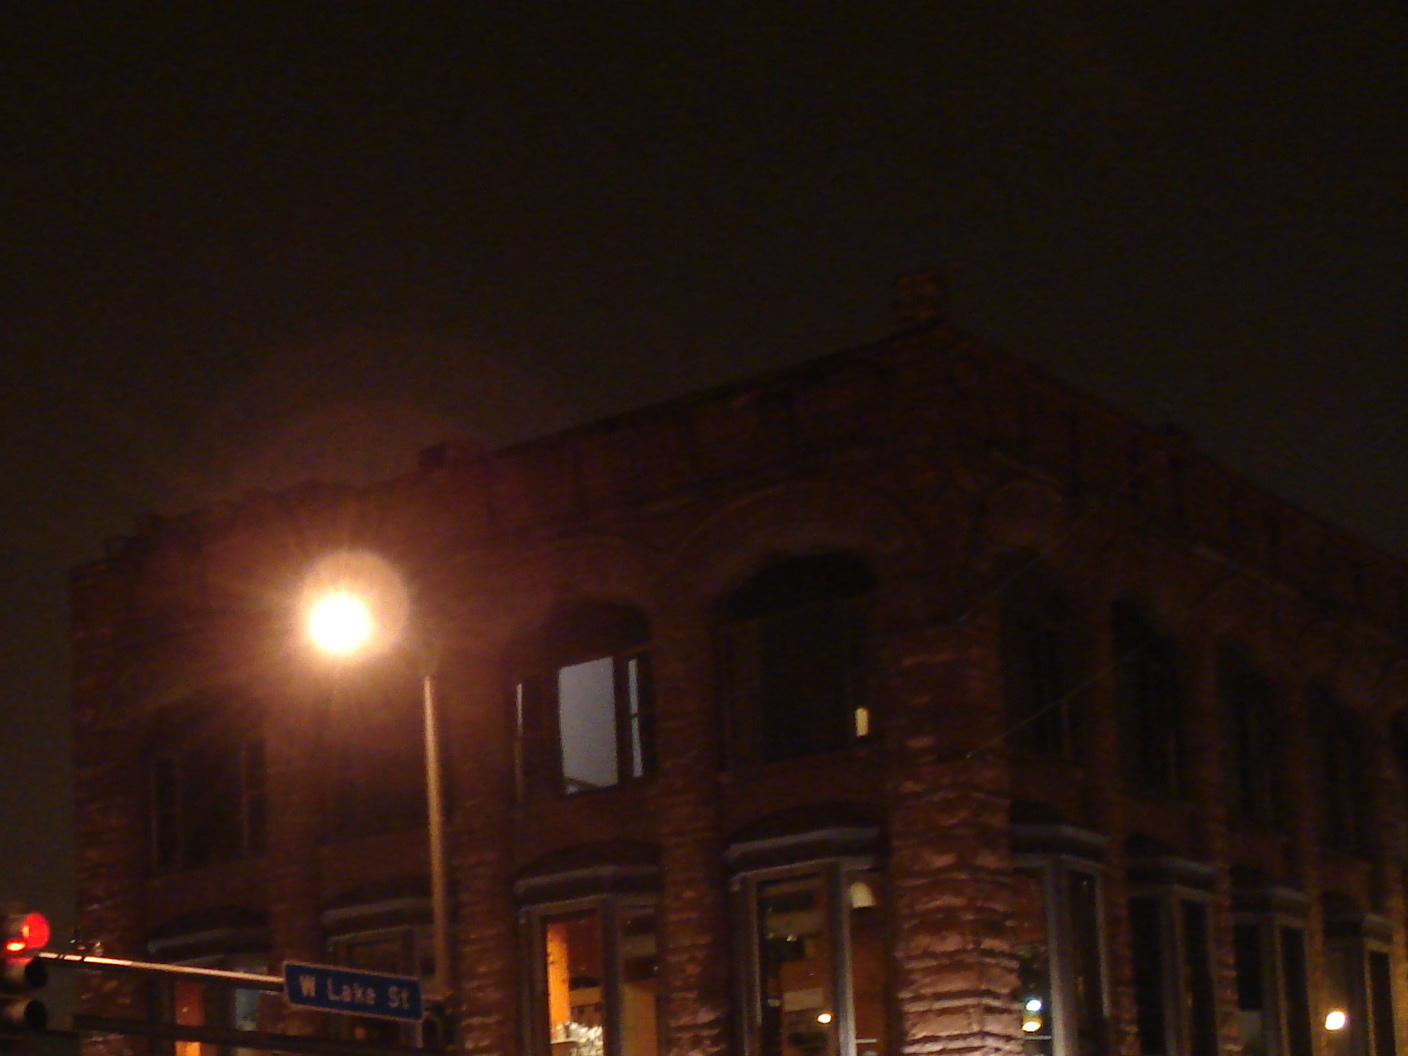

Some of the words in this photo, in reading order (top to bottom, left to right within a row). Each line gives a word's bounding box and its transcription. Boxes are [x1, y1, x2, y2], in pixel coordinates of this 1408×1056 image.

[298, 974, 317, 998] W
[327, 977, 376, 1006] Lake
[388, 985, 410, 1010] St
